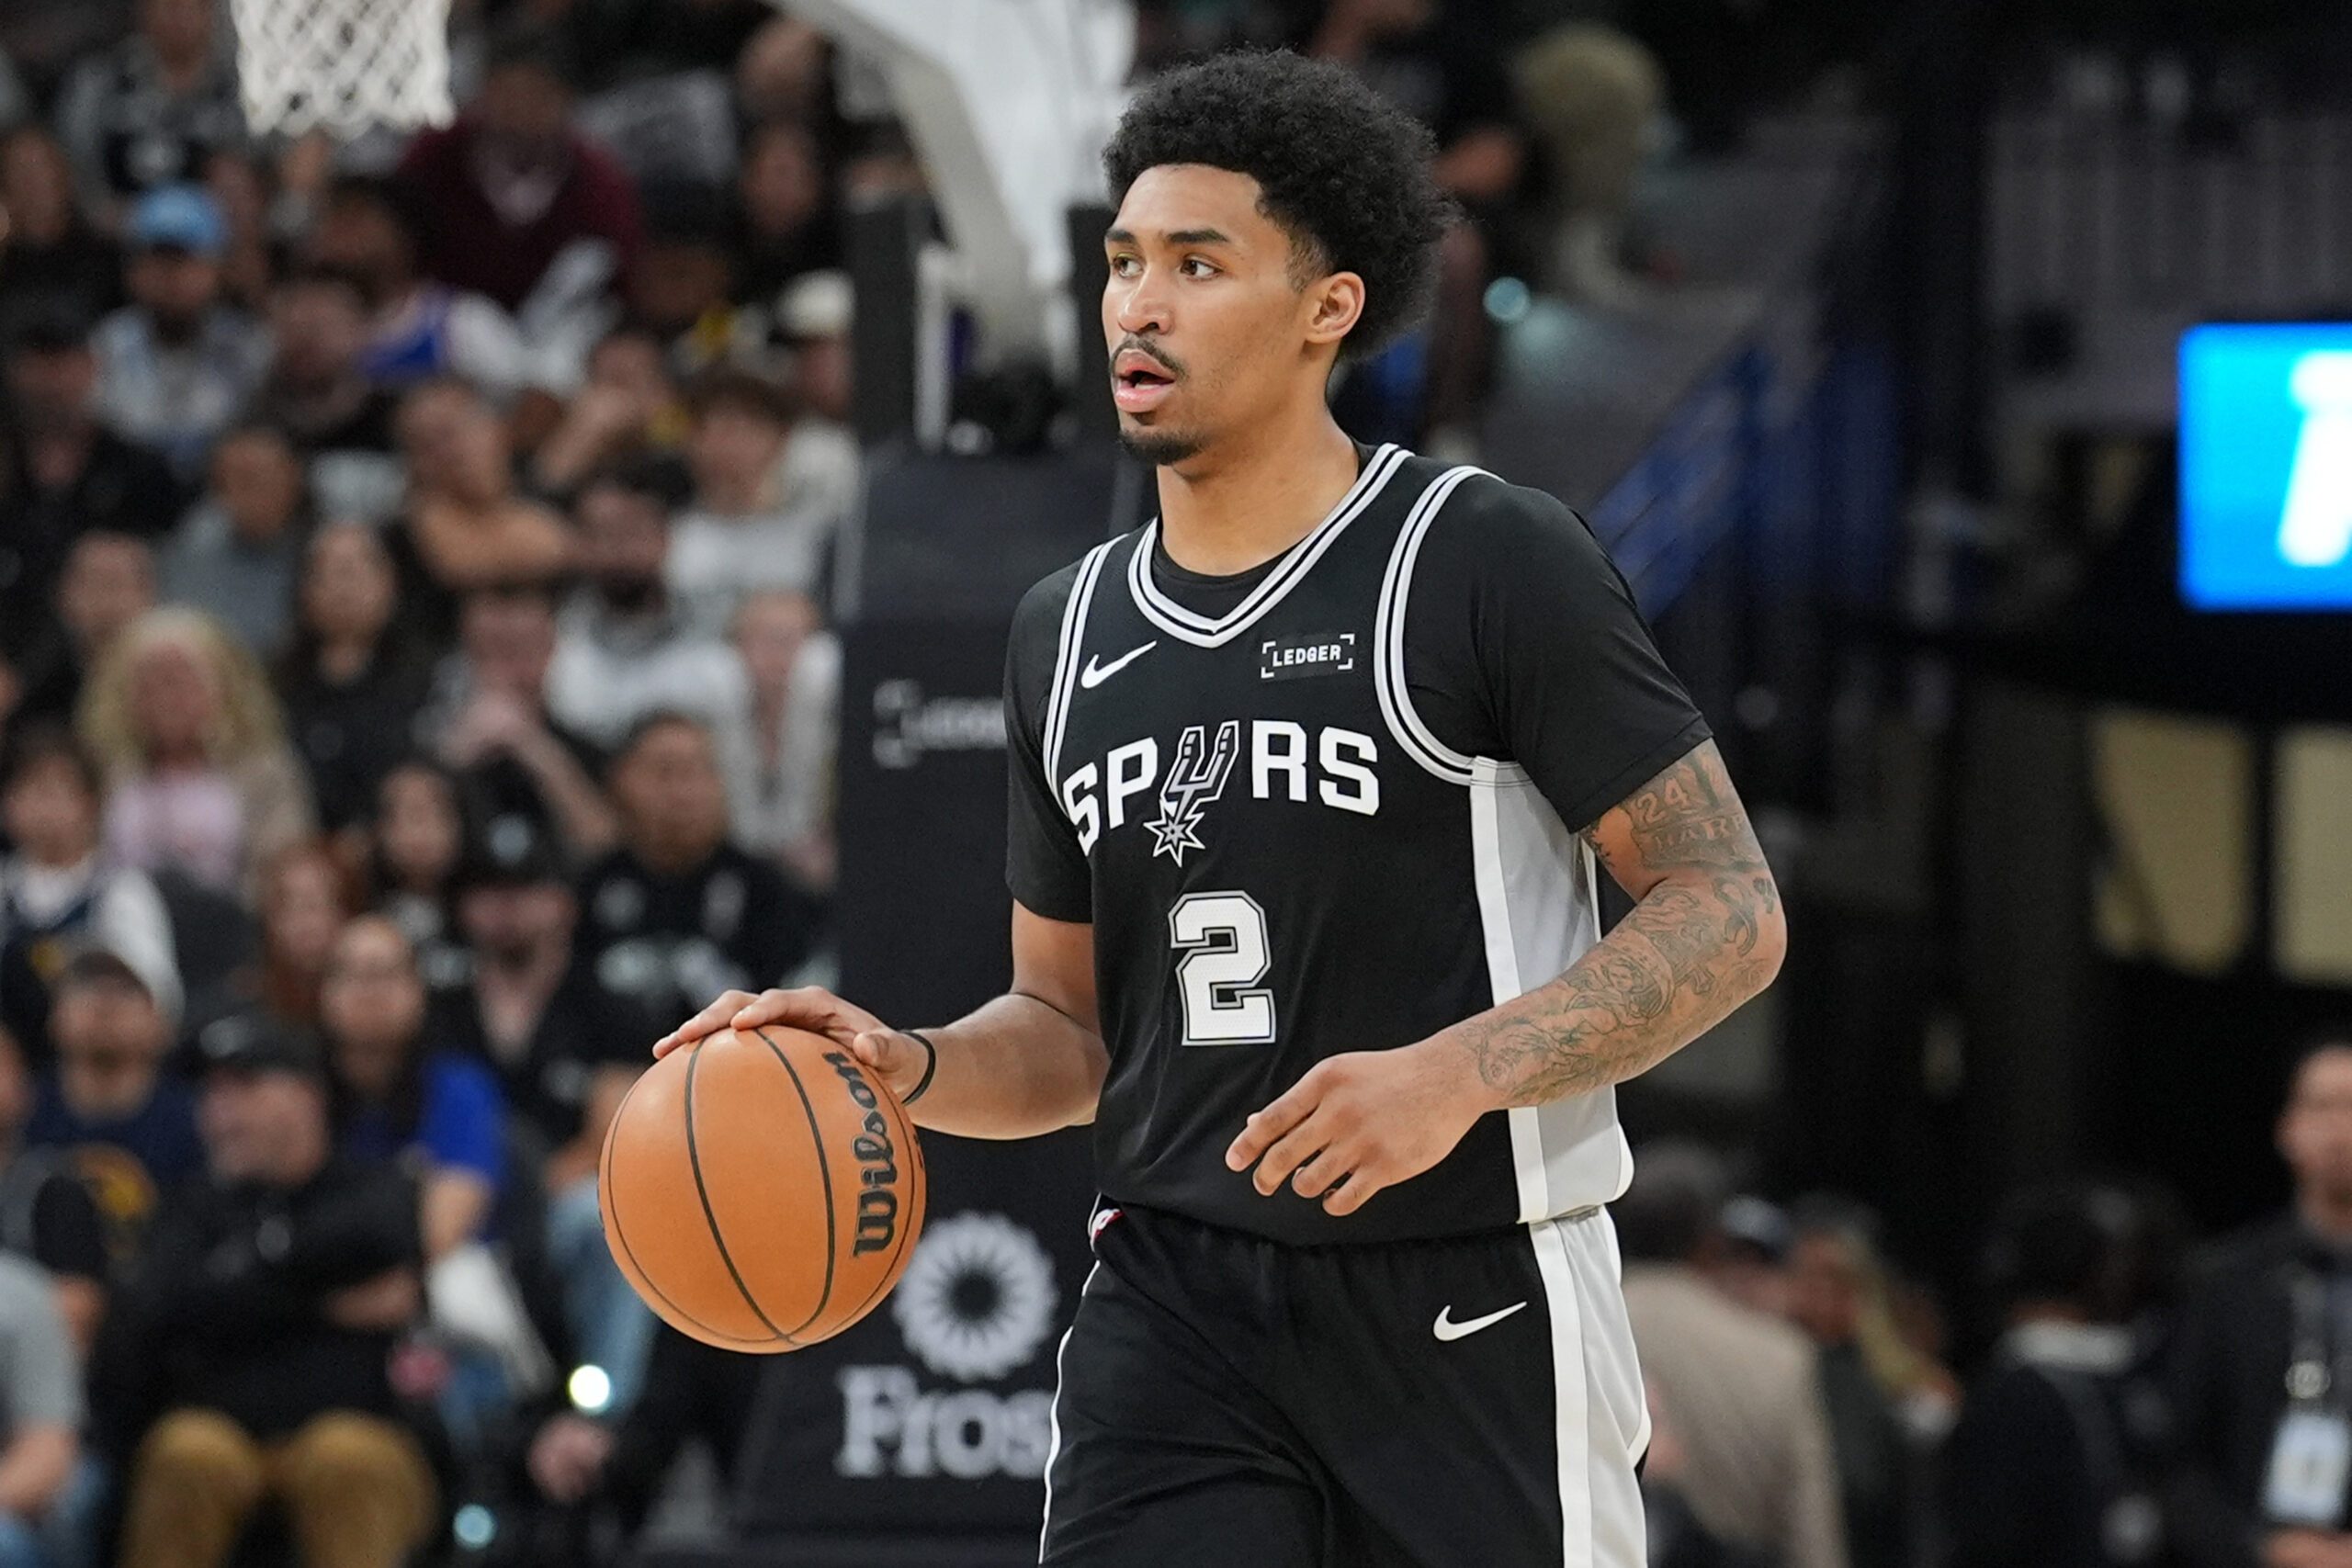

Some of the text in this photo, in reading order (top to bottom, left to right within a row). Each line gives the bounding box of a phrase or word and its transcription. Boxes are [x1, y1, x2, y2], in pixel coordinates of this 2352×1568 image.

[1272, 644, 1341, 667] LEDGER
[1063, 719, 1379, 867] SPURS
[1168, 890, 1276, 1046] 2
[822, 1051, 898, 1257] Wilson
